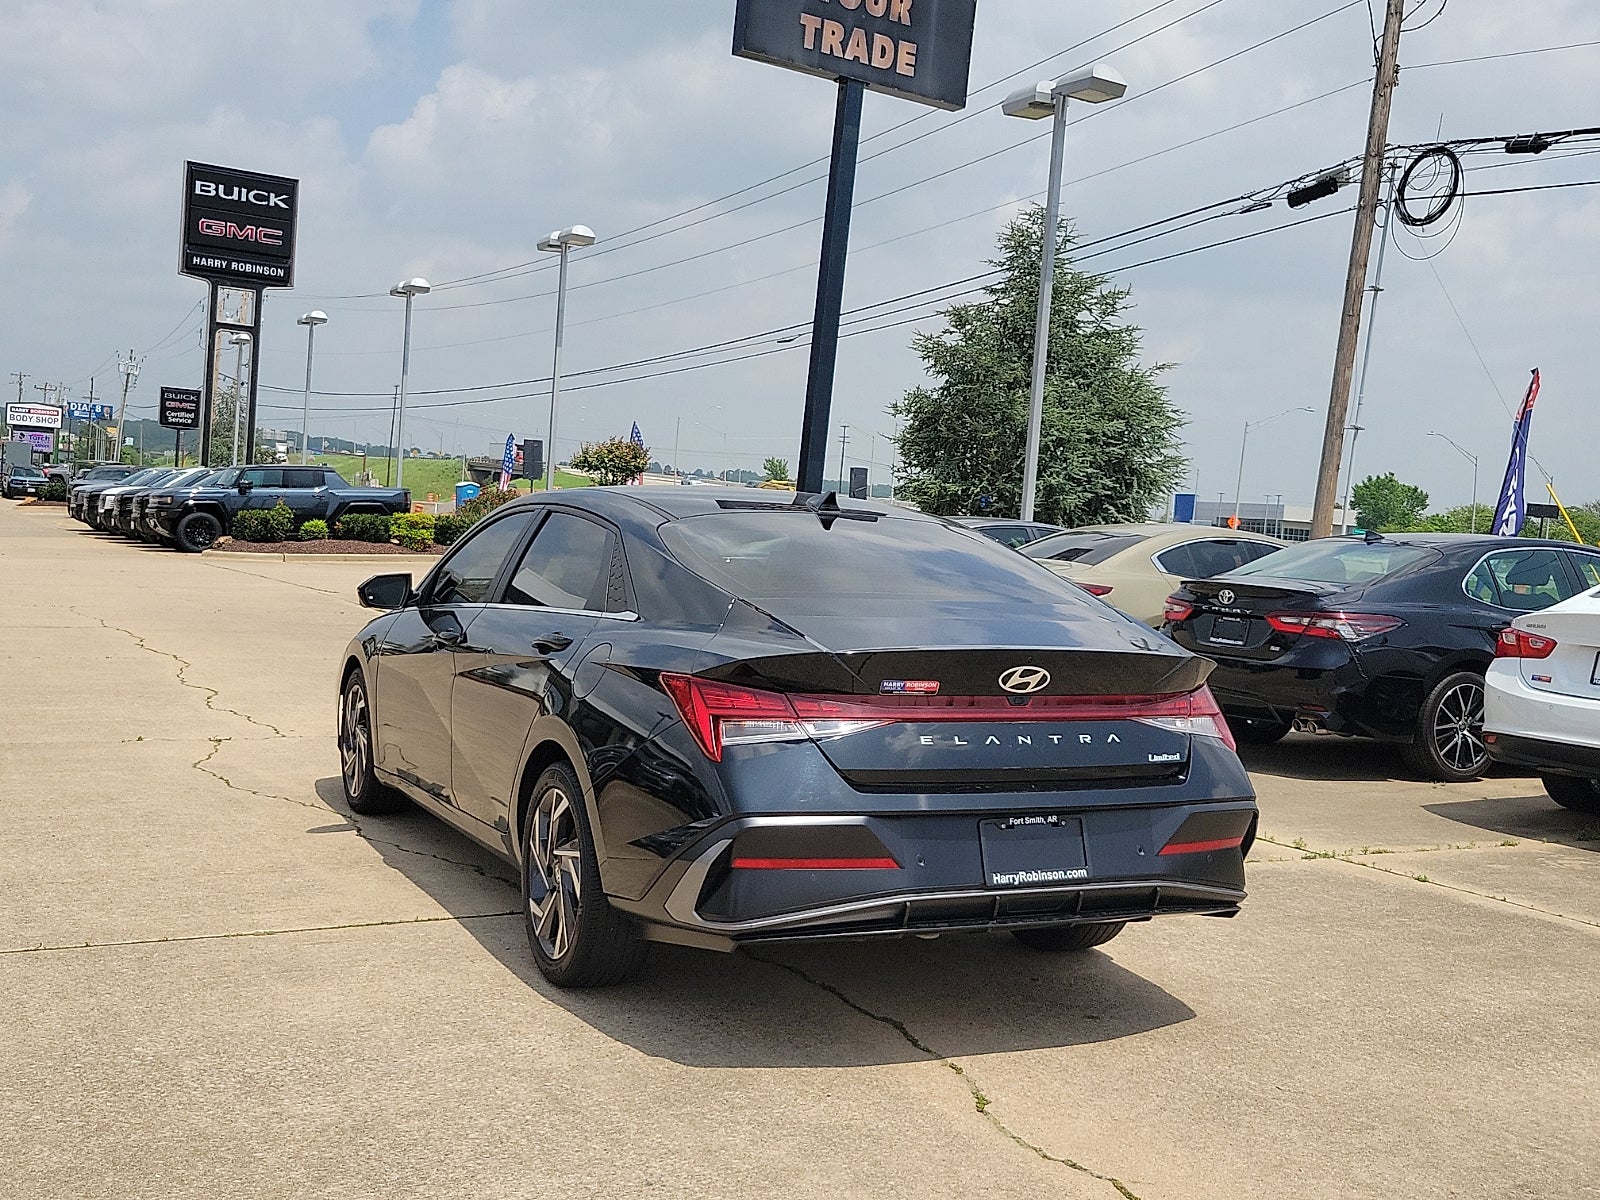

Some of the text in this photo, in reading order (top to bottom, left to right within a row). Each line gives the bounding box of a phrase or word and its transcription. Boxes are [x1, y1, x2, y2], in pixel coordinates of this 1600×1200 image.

[800, 13, 917, 77] TRADE
[194, 180, 290, 209] BUICK
[198, 218, 283, 246] GMC
[192, 256, 285, 277] HARRY ROBINSON
[164, 393, 198, 401] BUICK
[9, 413, 59, 425] BODY SHOP
[166, 410, 195, 419] Certified
[167, 416, 192, 424] Service
[919, 734, 1122, 746] ELANTRA
[1148, 752, 1181, 762] Limited
[1009, 815, 1058, 826] Fort Smith, AR
[992, 868, 1088, 885] HarryRobinson.com
